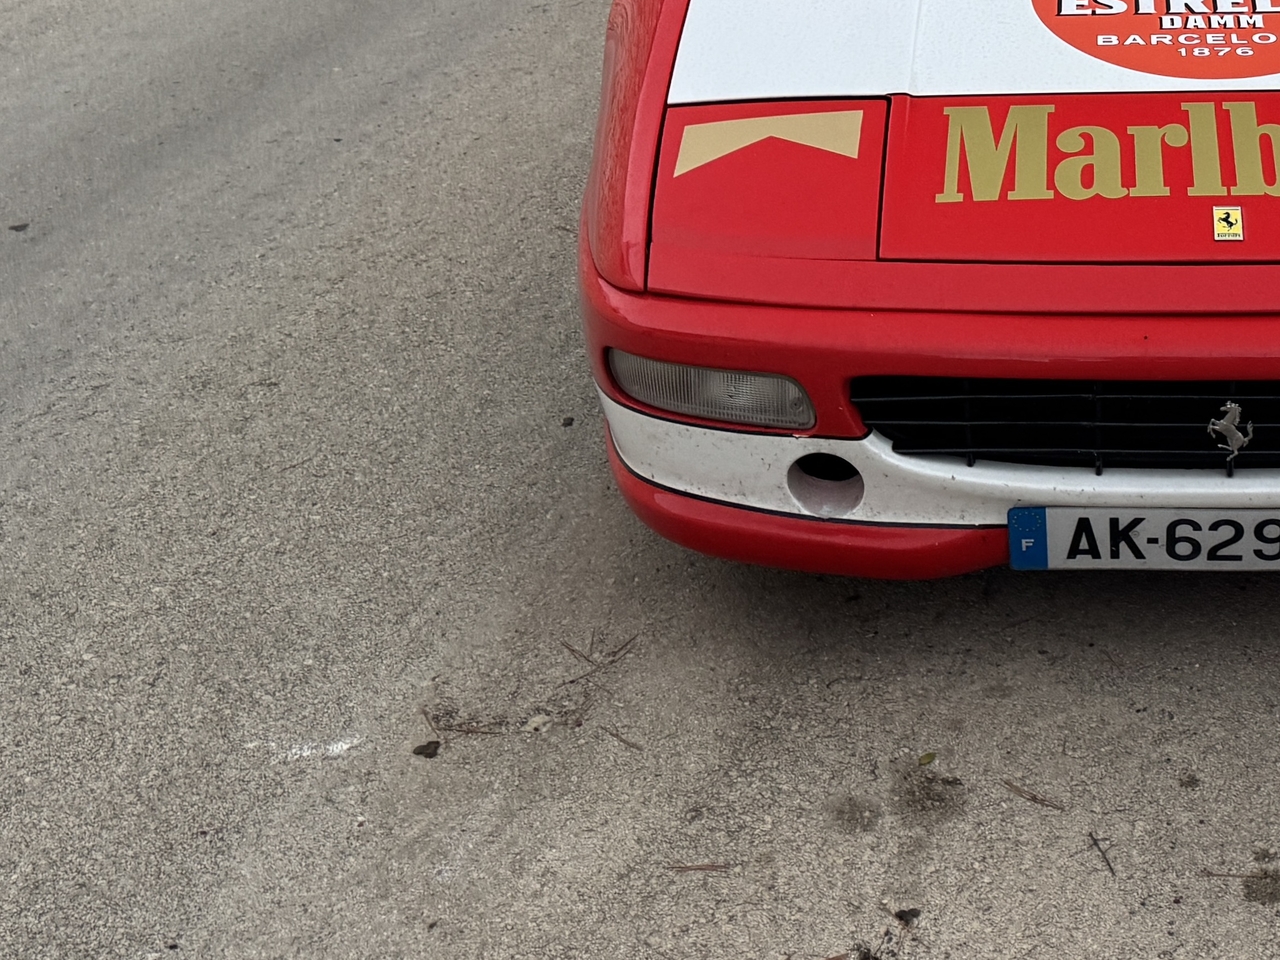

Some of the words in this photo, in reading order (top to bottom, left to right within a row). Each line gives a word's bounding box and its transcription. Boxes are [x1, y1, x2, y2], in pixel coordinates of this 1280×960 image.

[1158, 14, 1264, 30] DAMM
[1177, 47, 1254, 57] 1876
[1021, 538, 1034, 551] F
